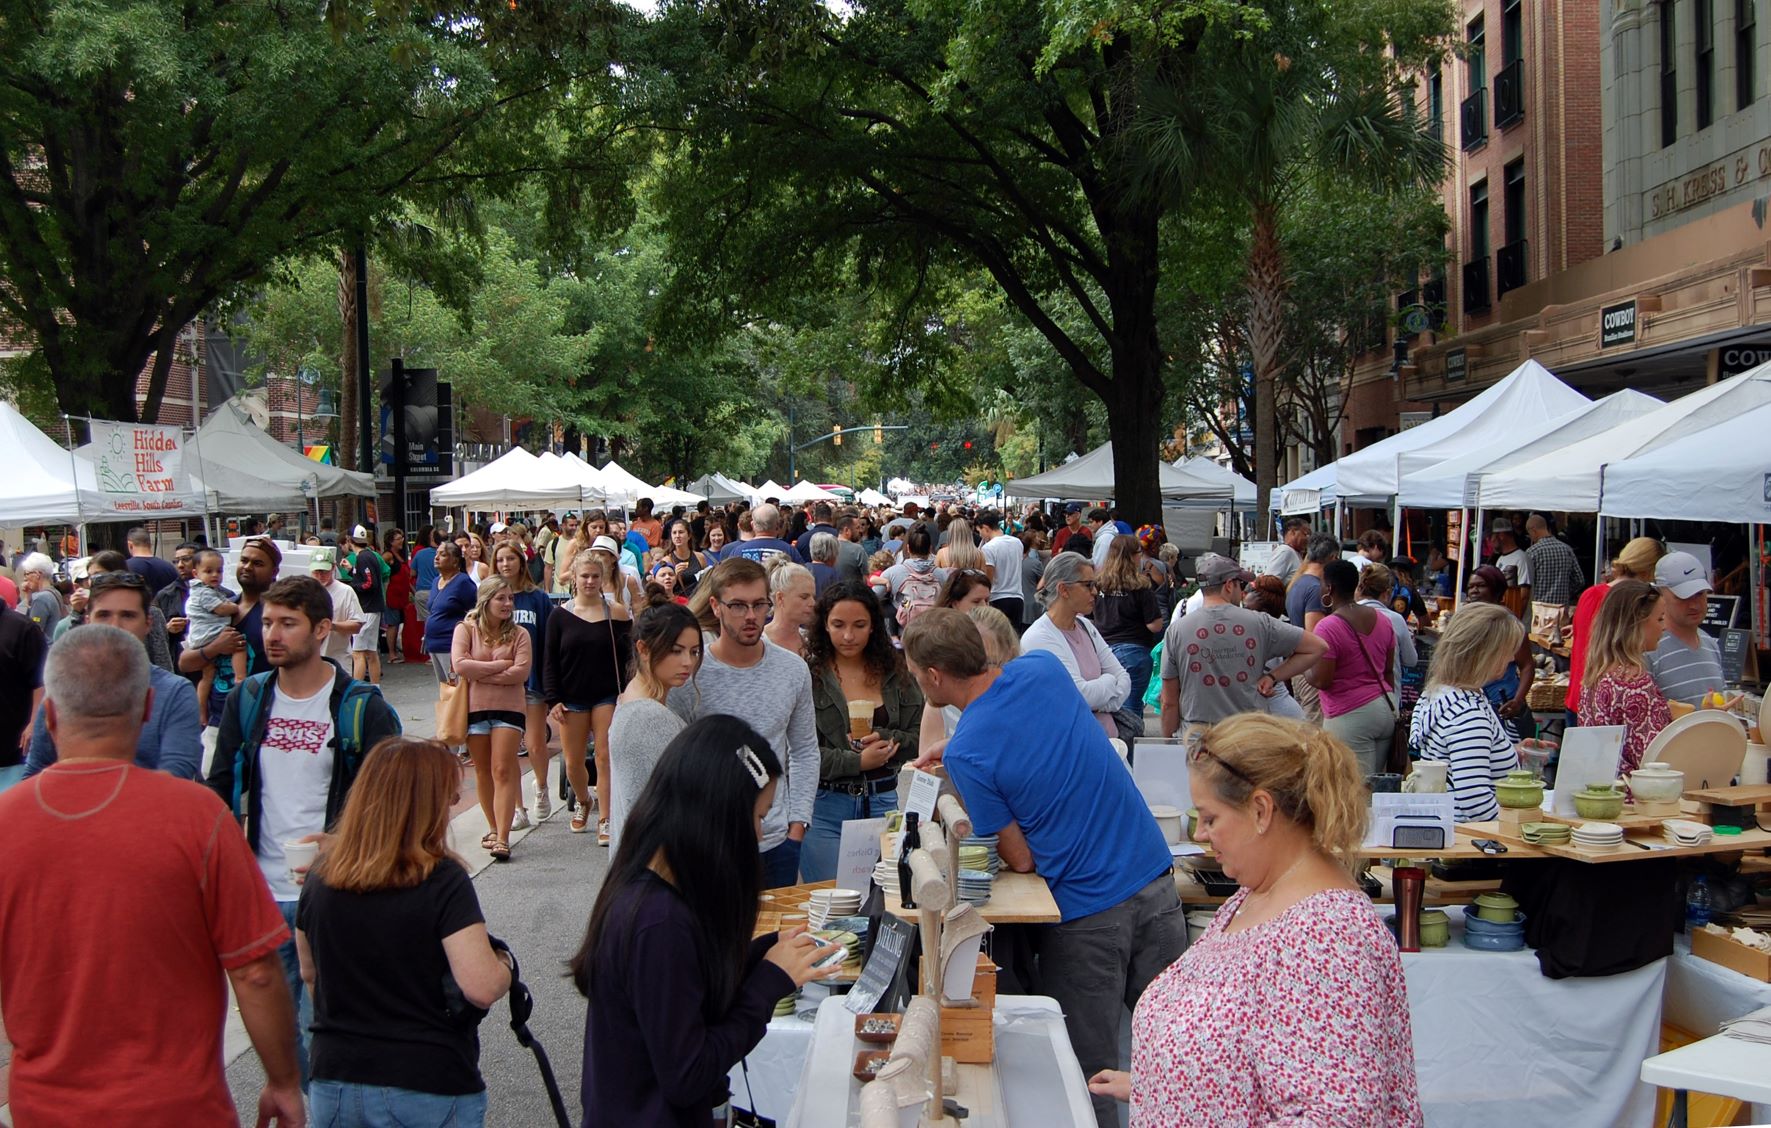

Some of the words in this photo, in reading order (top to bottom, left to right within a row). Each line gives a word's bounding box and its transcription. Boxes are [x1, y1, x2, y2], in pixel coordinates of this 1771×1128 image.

[1682, 164, 1726, 206] KRESS
[1735, 156, 1748, 184] &
[1604, 307, 1634, 329] COWBOY
[408, 442, 424, 451] Main
[134, 452, 164, 473] Hills
[408, 452, 427, 464] Street
[136, 474, 175, 492] Farm
